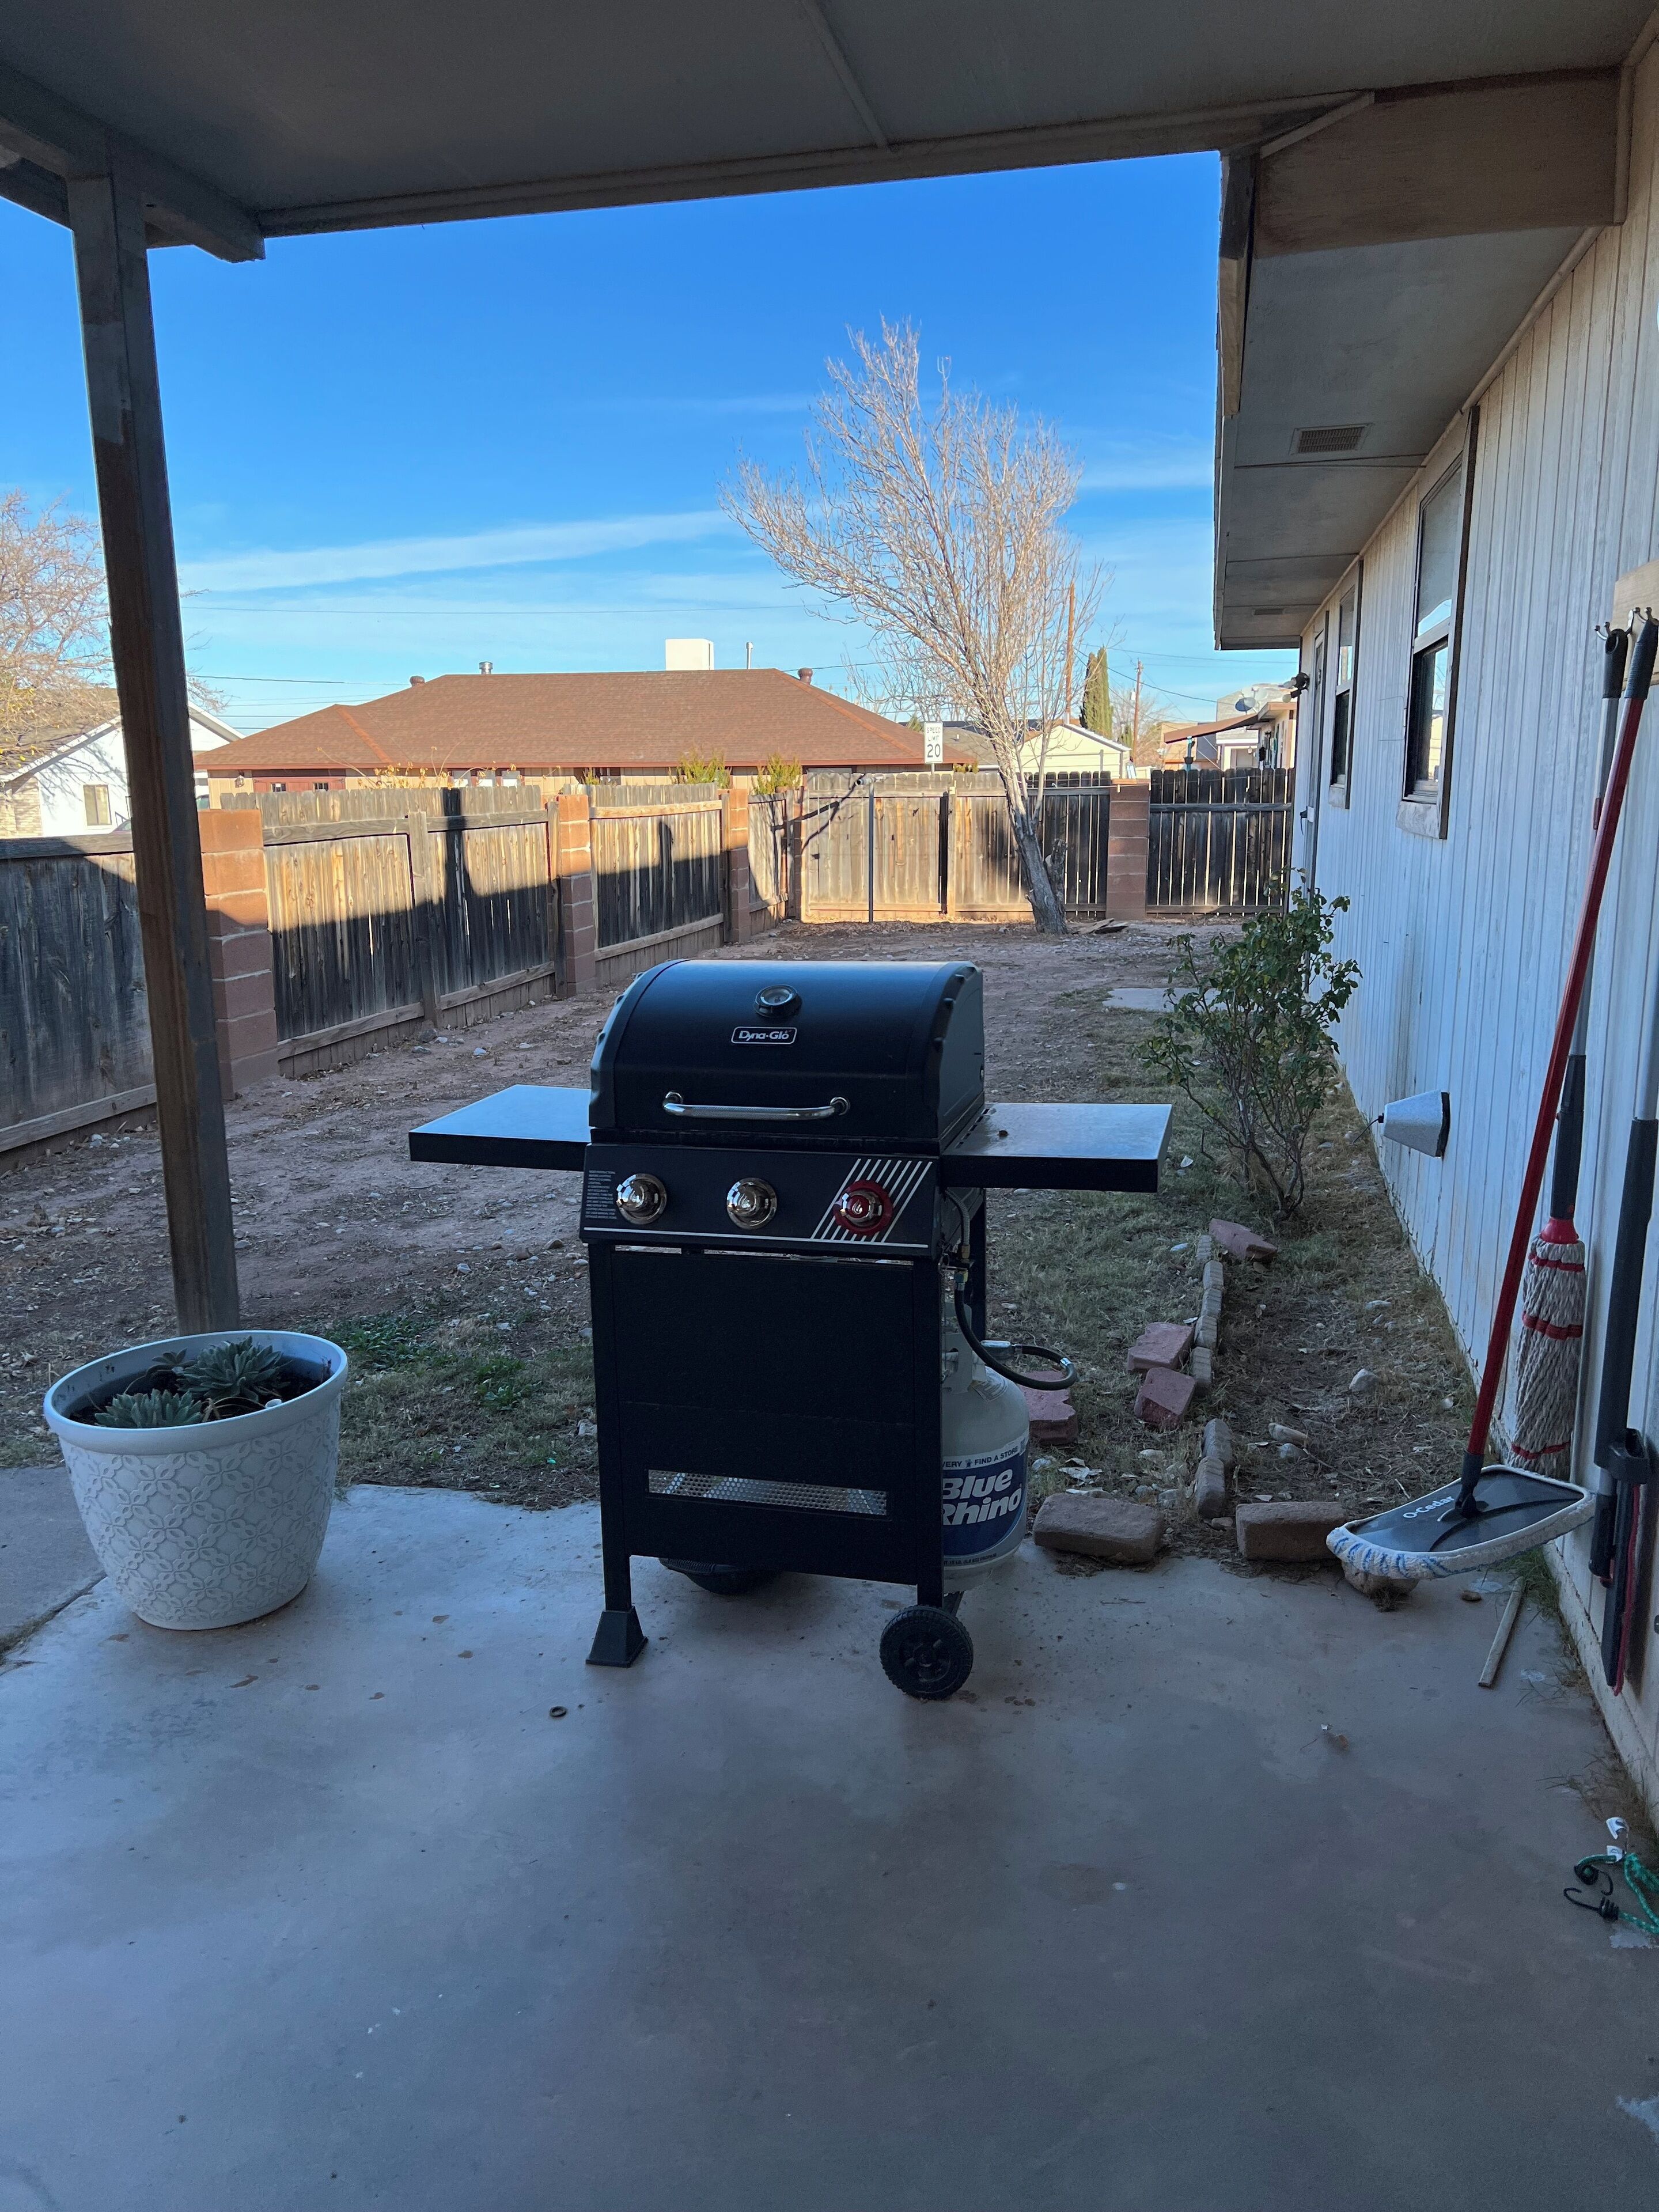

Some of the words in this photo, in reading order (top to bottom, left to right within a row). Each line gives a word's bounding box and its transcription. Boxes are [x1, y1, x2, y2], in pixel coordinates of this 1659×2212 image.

[927, 744, 941, 757] 20
[738, 1031, 789, 1041] Dyna-Glo
[975, 1457, 992, 1465] FIND
[1000, 1446, 1018, 1459] STORE
[942, 1469, 1013, 1499] Blue
[942, 1488, 1022, 1525] Rhino
[1403, 1496, 1455, 1518] O-Cedar
